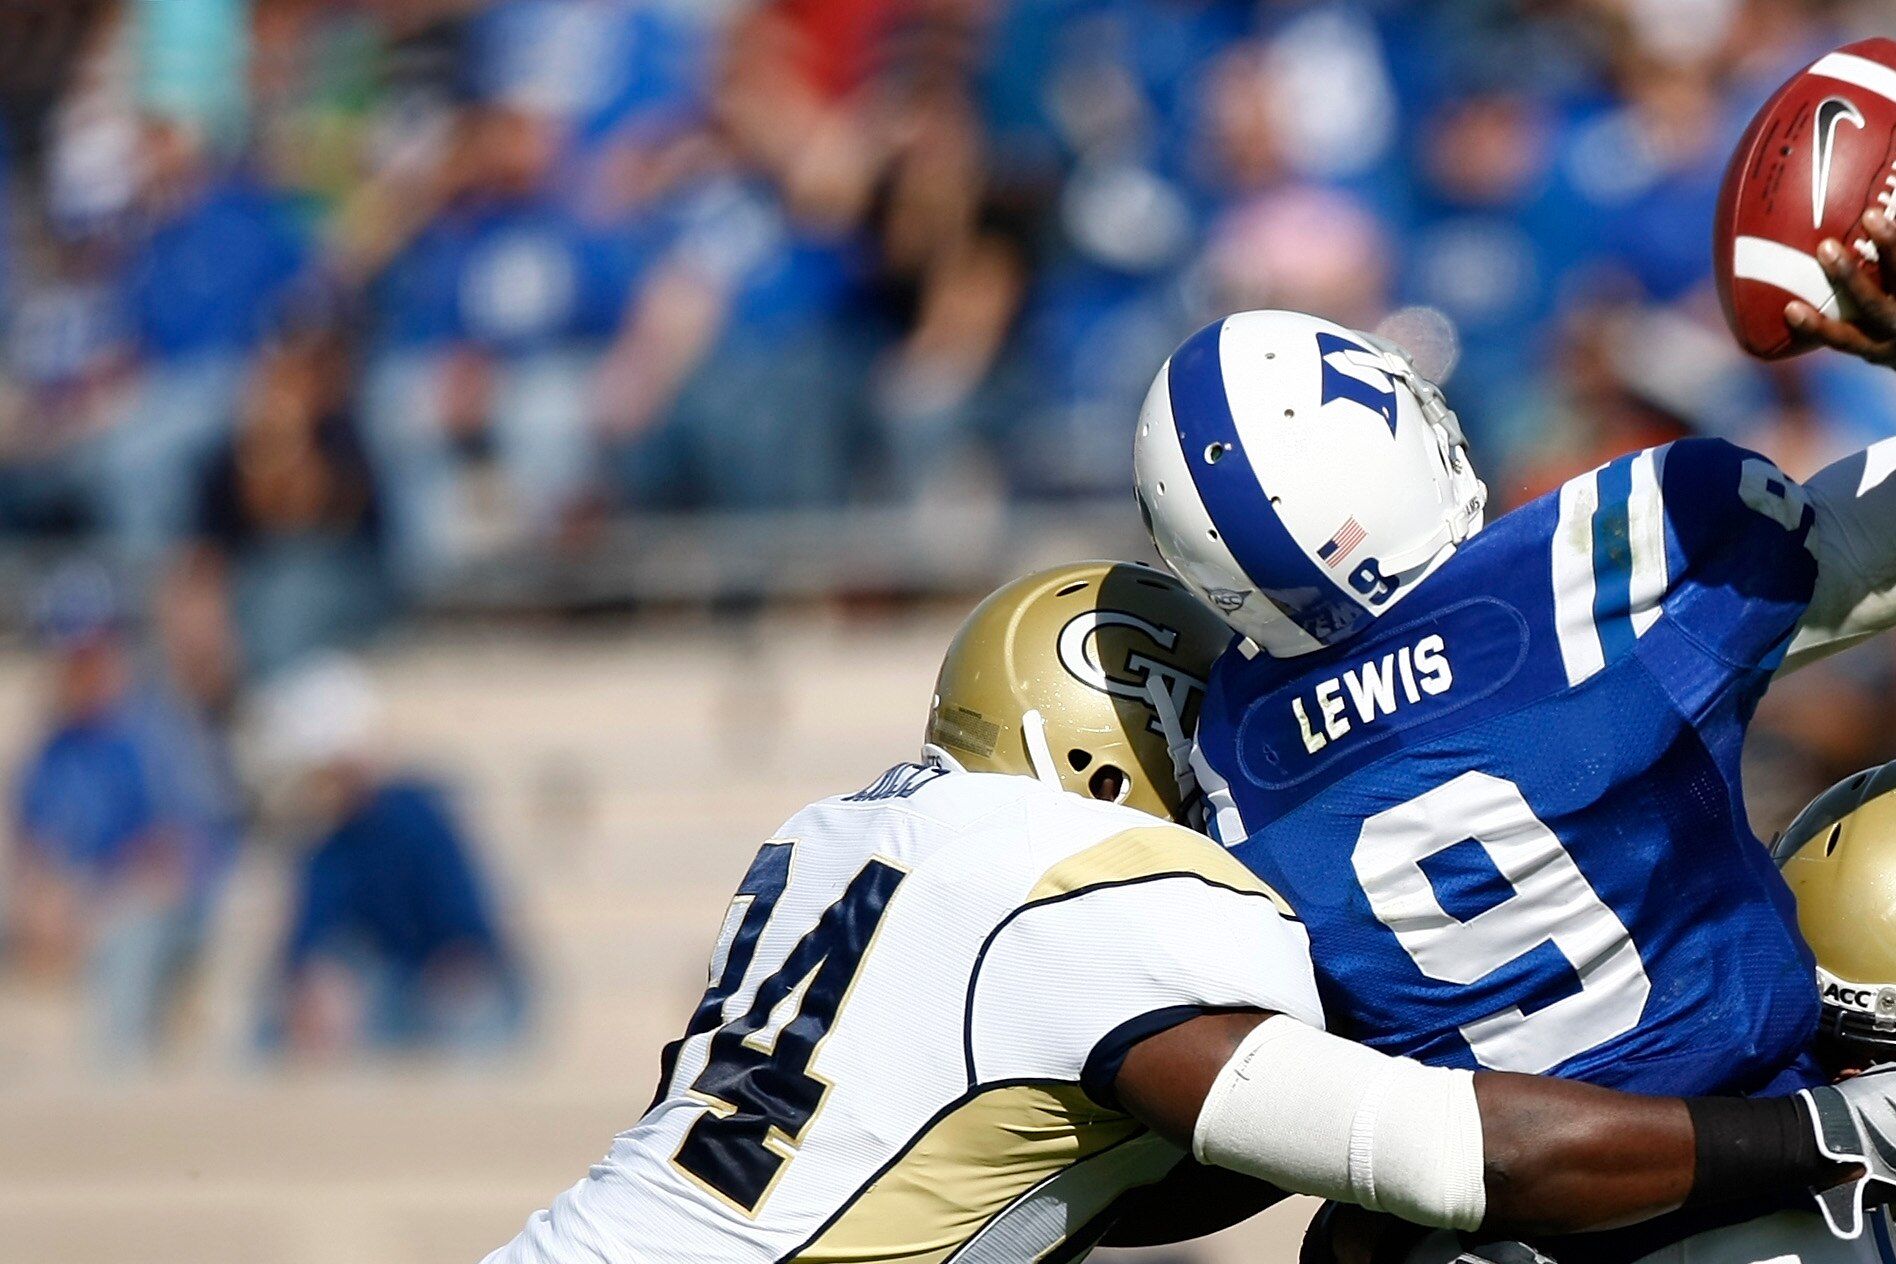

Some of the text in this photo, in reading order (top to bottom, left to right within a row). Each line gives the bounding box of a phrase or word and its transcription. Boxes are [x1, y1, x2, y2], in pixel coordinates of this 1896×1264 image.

[1347, 556, 1401, 606] 9
[1291, 633, 1453, 755] LEWIS
[1350, 769, 1652, 1076] 9
[1823, 983, 1872, 1008] ACC
